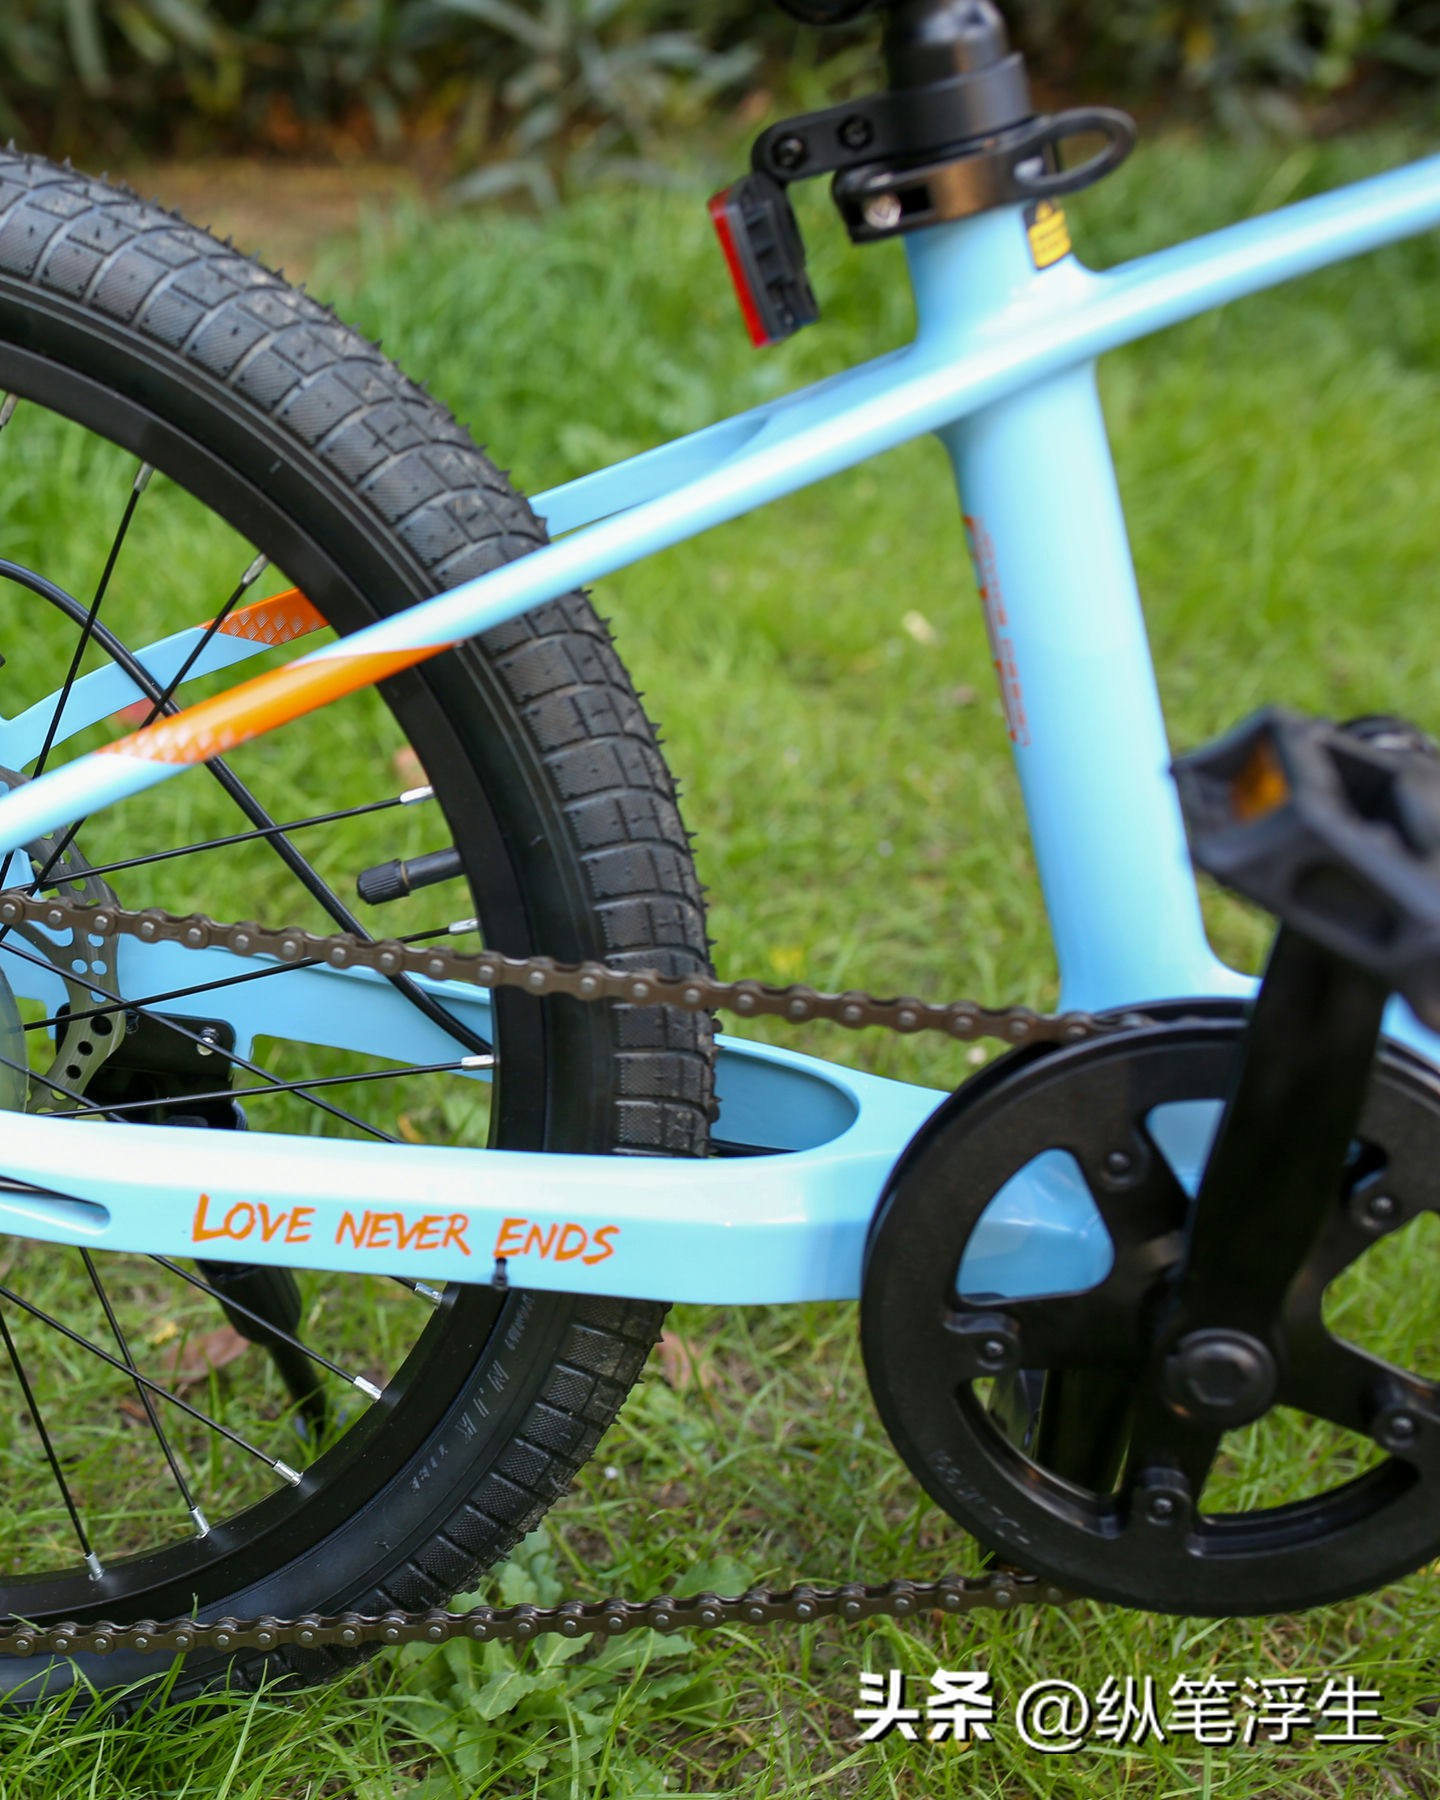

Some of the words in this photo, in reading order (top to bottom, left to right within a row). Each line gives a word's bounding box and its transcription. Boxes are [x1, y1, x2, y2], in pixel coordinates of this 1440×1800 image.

[191, 1193, 316, 1242] LOVE
[334, 1209, 472, 1256] NEVER
[493, 1216, 621, 1265] ENDS
